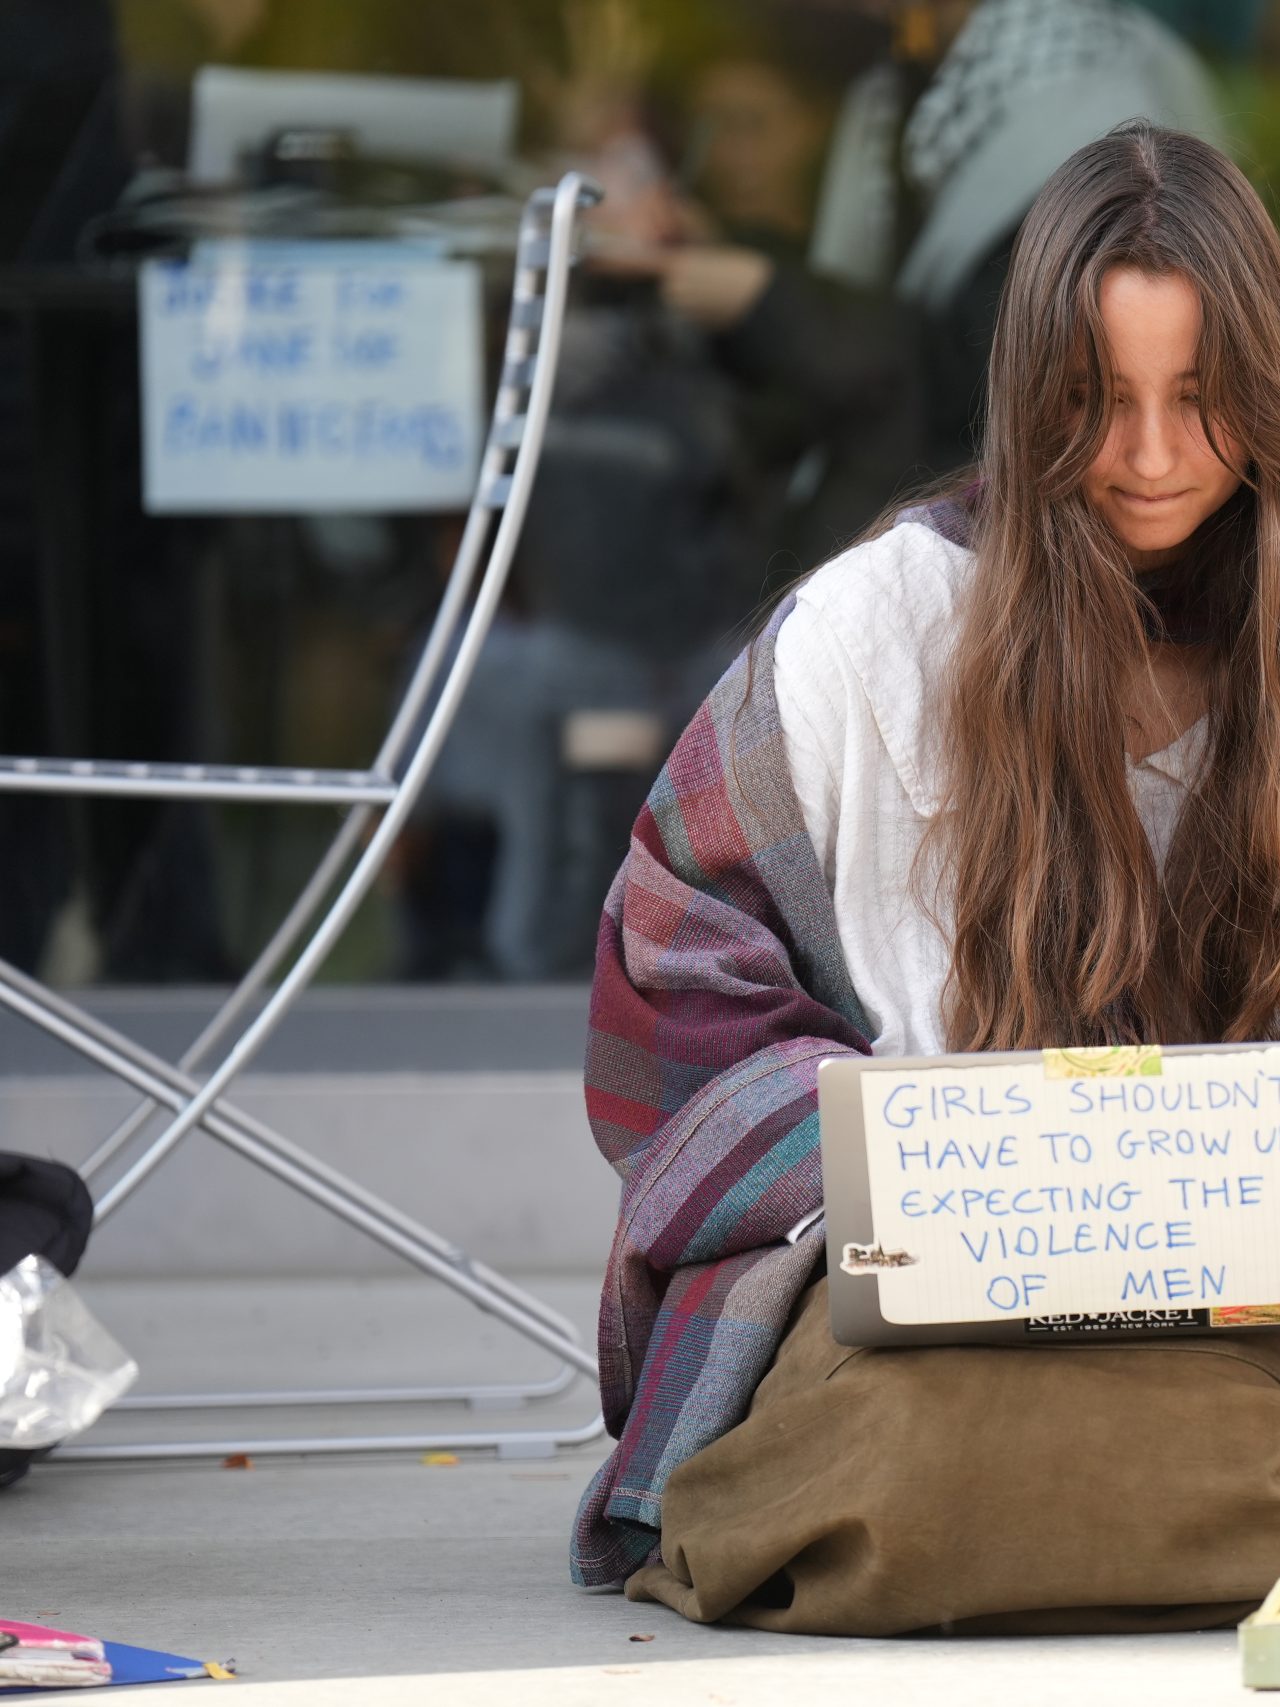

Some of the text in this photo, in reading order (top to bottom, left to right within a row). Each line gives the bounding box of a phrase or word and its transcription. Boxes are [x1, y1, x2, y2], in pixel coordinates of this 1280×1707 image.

[883, 1083, 1032, 1128] GIRLS
[898, 1135, 1018, 1171] HAVE
[1041, 1132, 1092, 1164] TO
[1118, 1129, 1230, 1159] GROW
[901, 1176, 1264, 1217] EXPECTING THE
[960, 1221, 1197, 1263] VIOLENCE
[987, 1265, 1227, 1311] OF MEN
